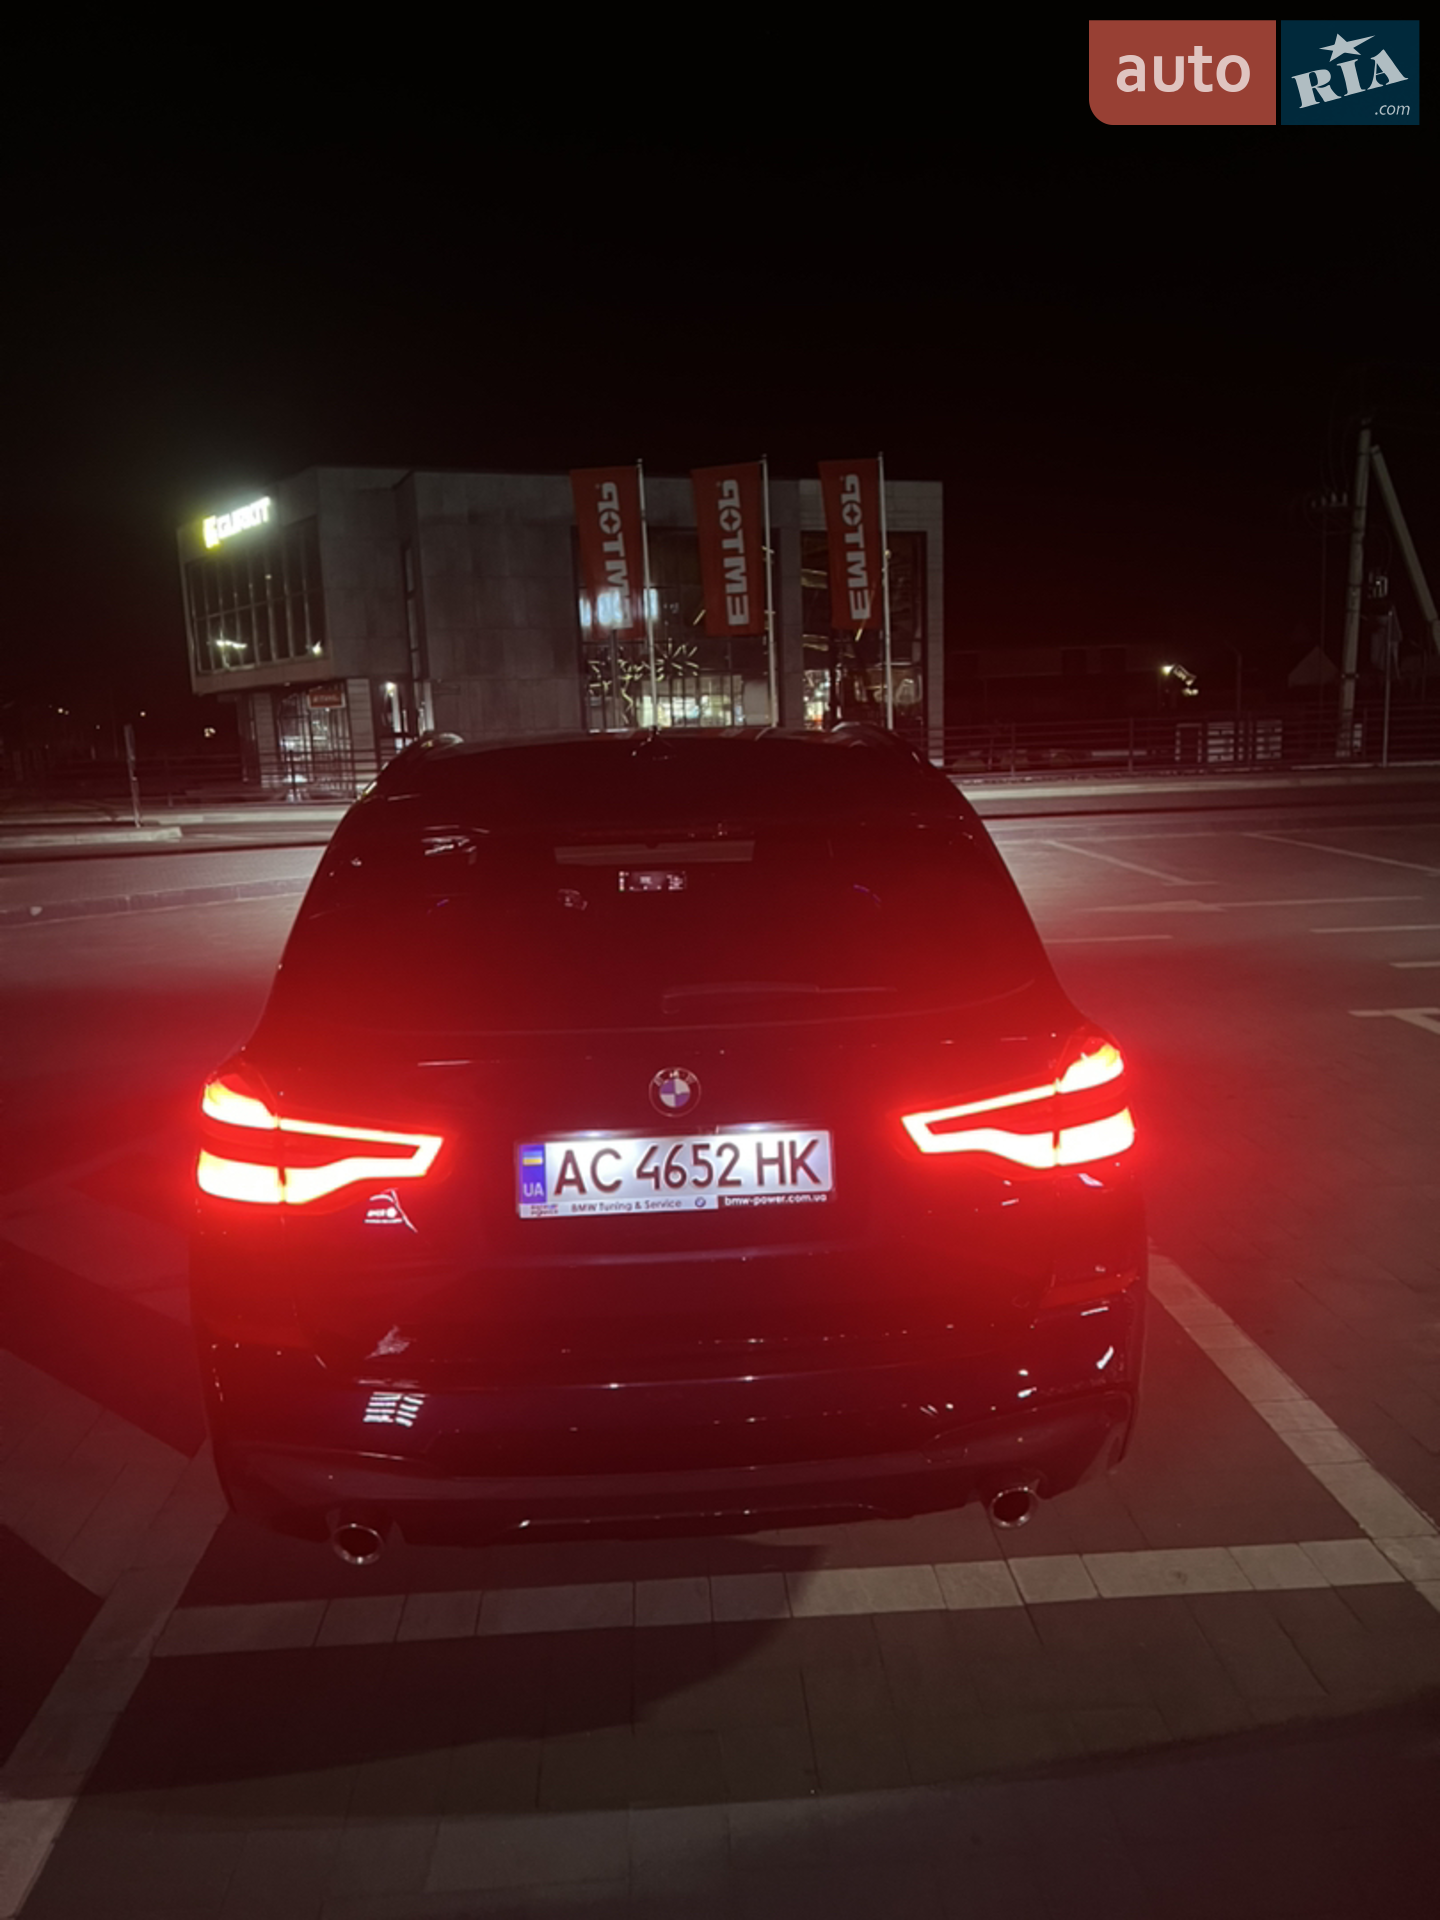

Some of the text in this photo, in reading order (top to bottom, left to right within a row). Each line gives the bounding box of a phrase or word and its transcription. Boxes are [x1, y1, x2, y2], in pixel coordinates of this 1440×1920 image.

[554, 1139, 821, 1196] AC 4652 HK
[523, 1182, 545, 1198] UA
[571, 1202, 597, 1214] BMW
[645, 1200, 682, 1210] Service
